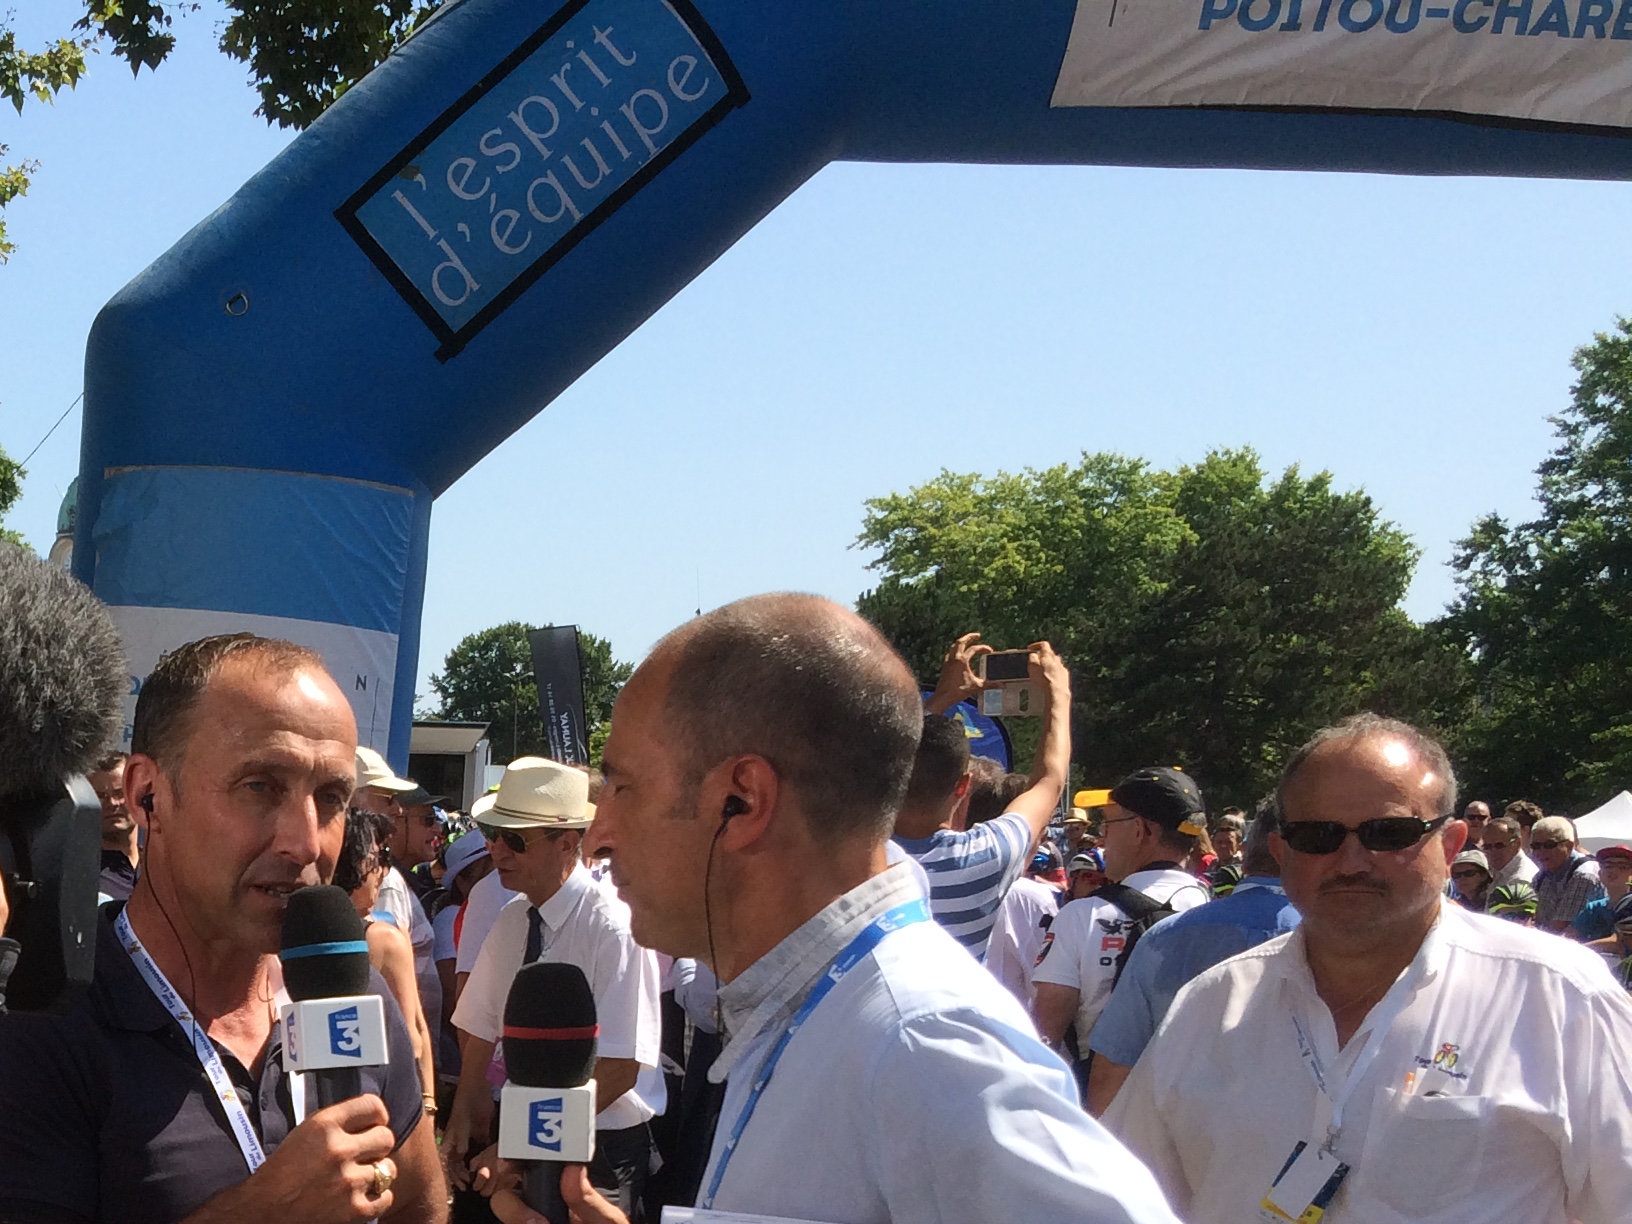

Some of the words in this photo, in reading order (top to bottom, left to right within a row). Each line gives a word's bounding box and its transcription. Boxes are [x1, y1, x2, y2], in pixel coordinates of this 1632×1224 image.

[431, 55, 710, 307] d'équipe
[336, 1021, 361, 1051] 3
[236, 1110, 258, 1152] Limousin
[536, 1111, 562, 1144] 3
